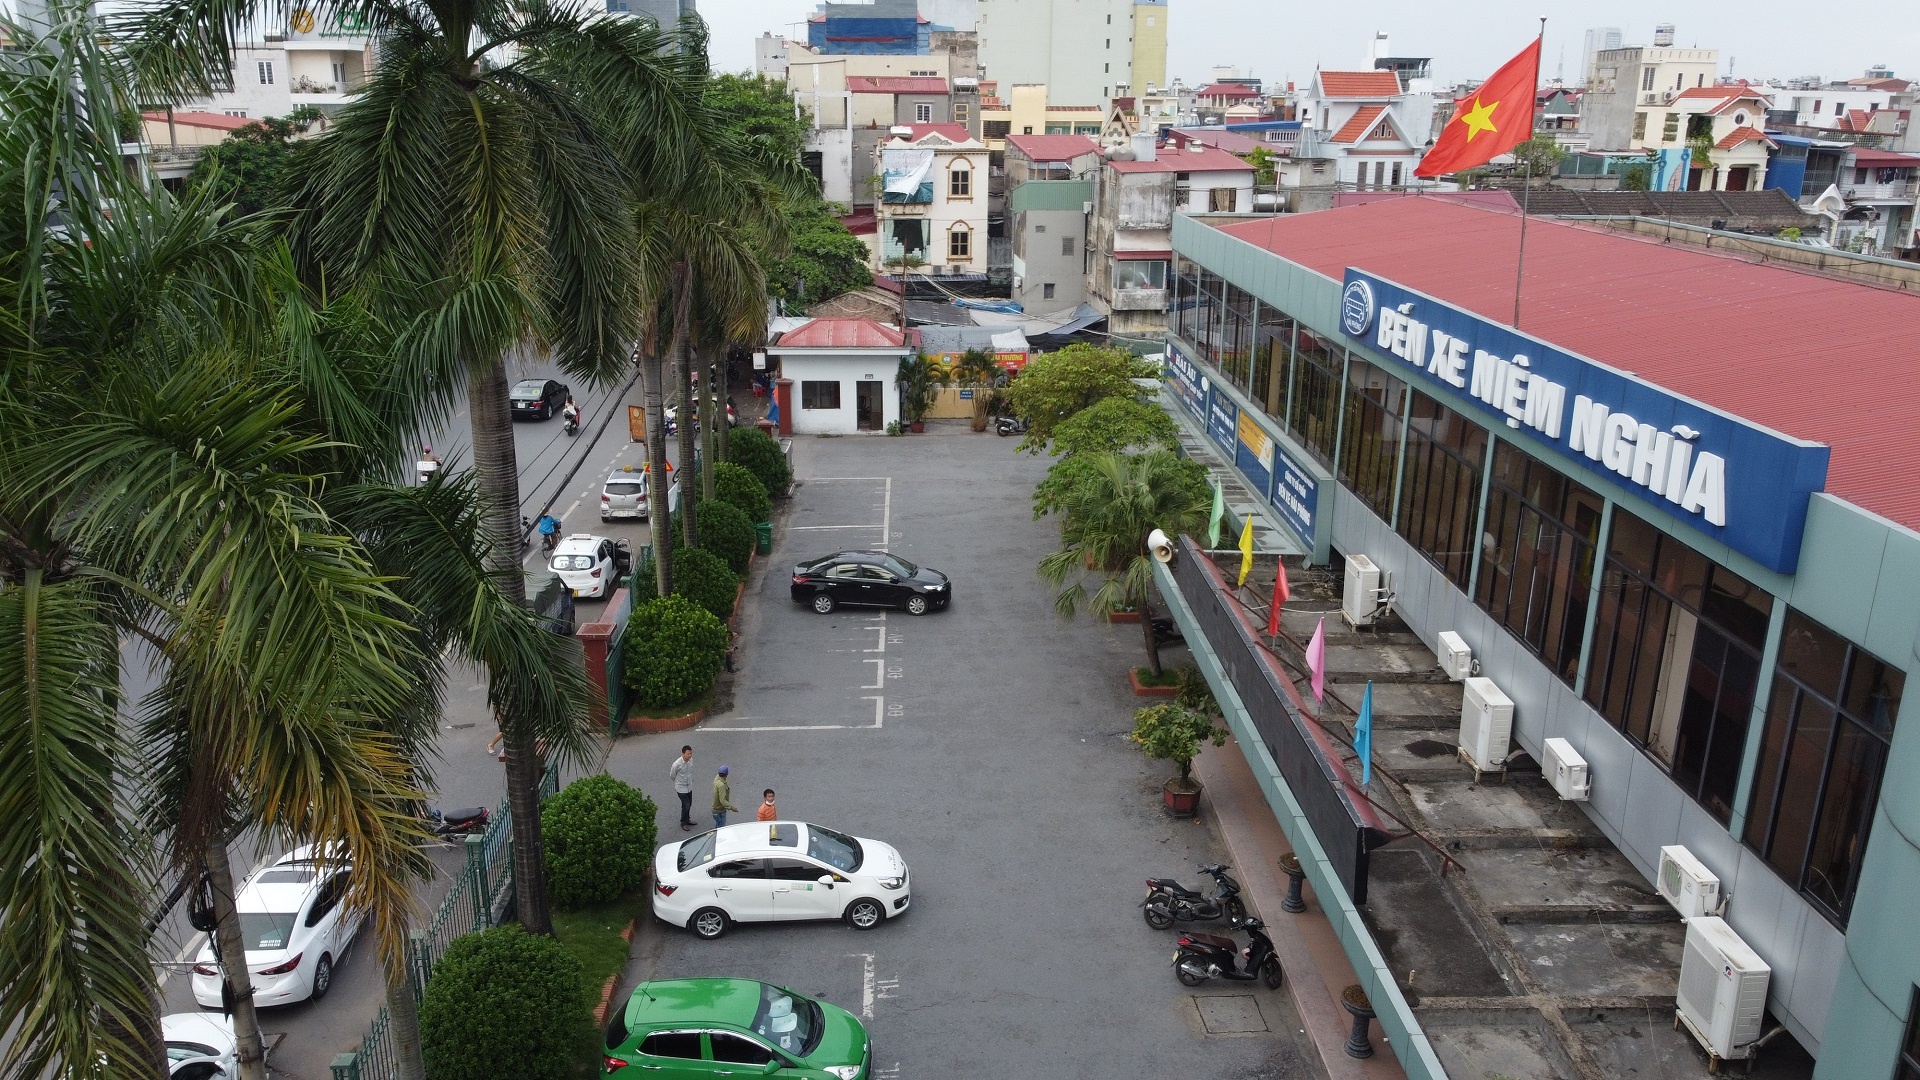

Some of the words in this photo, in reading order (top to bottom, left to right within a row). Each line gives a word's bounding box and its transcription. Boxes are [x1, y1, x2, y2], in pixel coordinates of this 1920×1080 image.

[1378, 303, 1428, 367] BẾN
[1427, 329, 1469, 388] XE
[1470, 349, 1566, 439] NIỆM
[1569, 395, 1725, 527] NGHĨA
